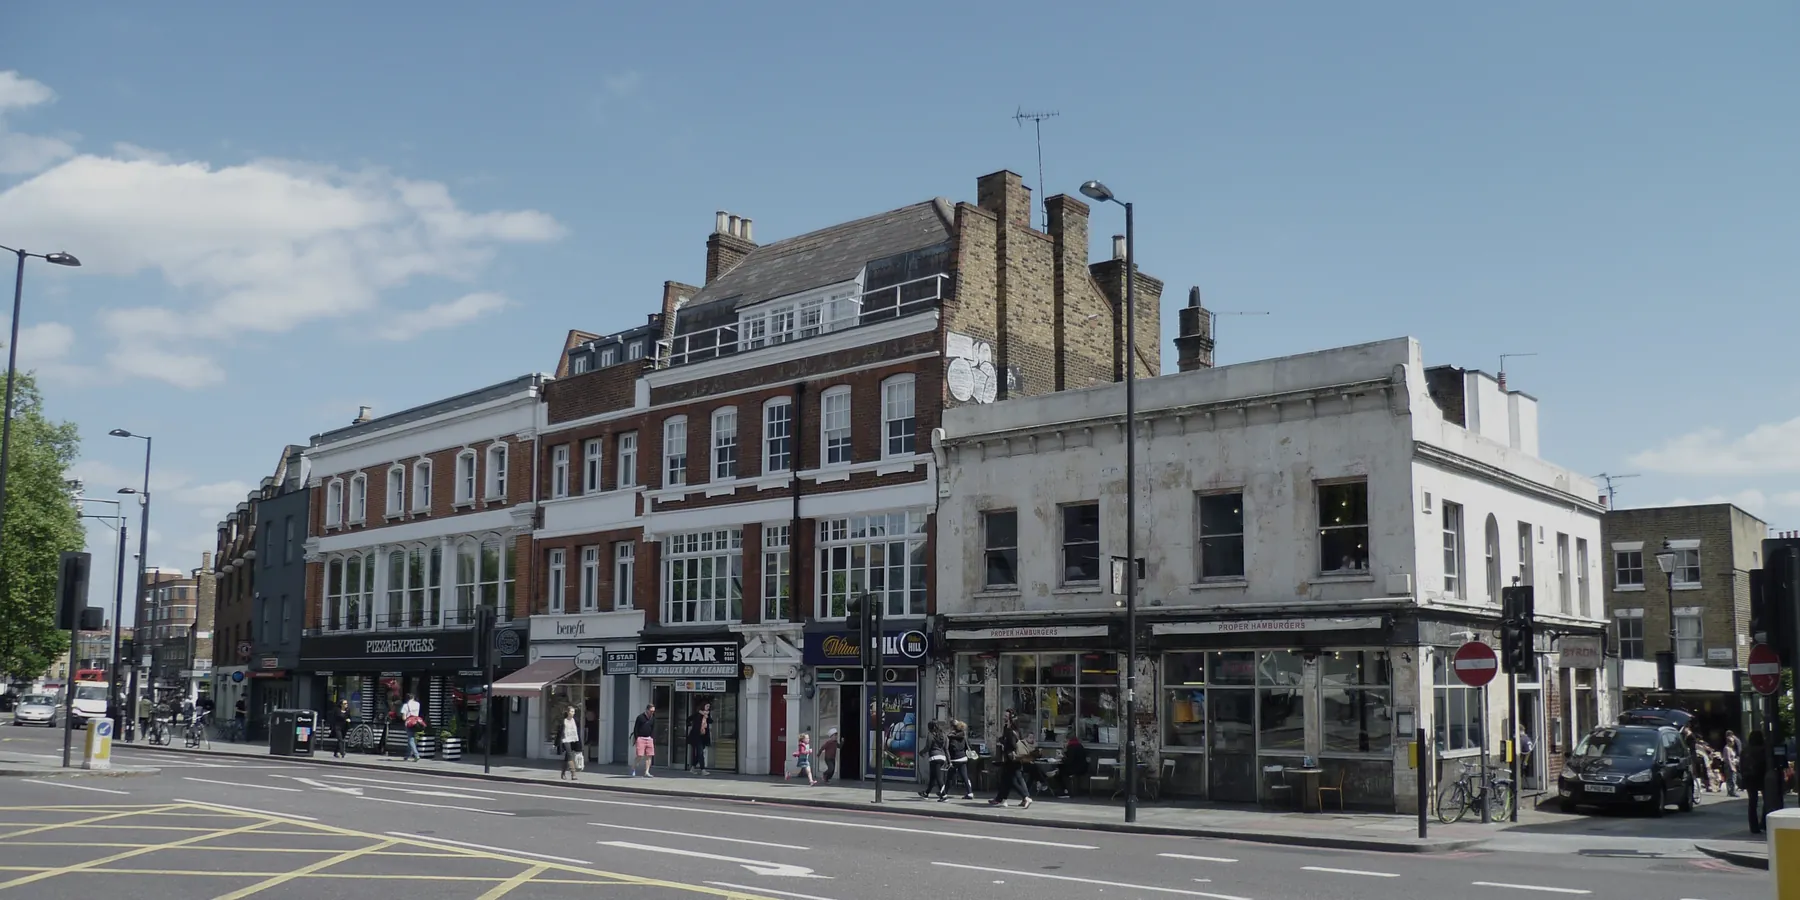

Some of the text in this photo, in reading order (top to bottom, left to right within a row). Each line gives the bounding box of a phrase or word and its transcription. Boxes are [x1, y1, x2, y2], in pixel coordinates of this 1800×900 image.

[556, 620, 585, 637] benefit
[1218, 622, 1305, 631] PROPER HAMBURGERS
[366, 639, 434, 653] PIZZAEXPRESS
[908, 642, 921, 652] HILL
[656, 647, 717, 662] 5 STAR
[1563, 648, 1598, 657] BYRON
[576, 656, 600, 666] benefit
[701, 666, 735, 674] CLEANERS
[701, 681, 714, 691] ALL
